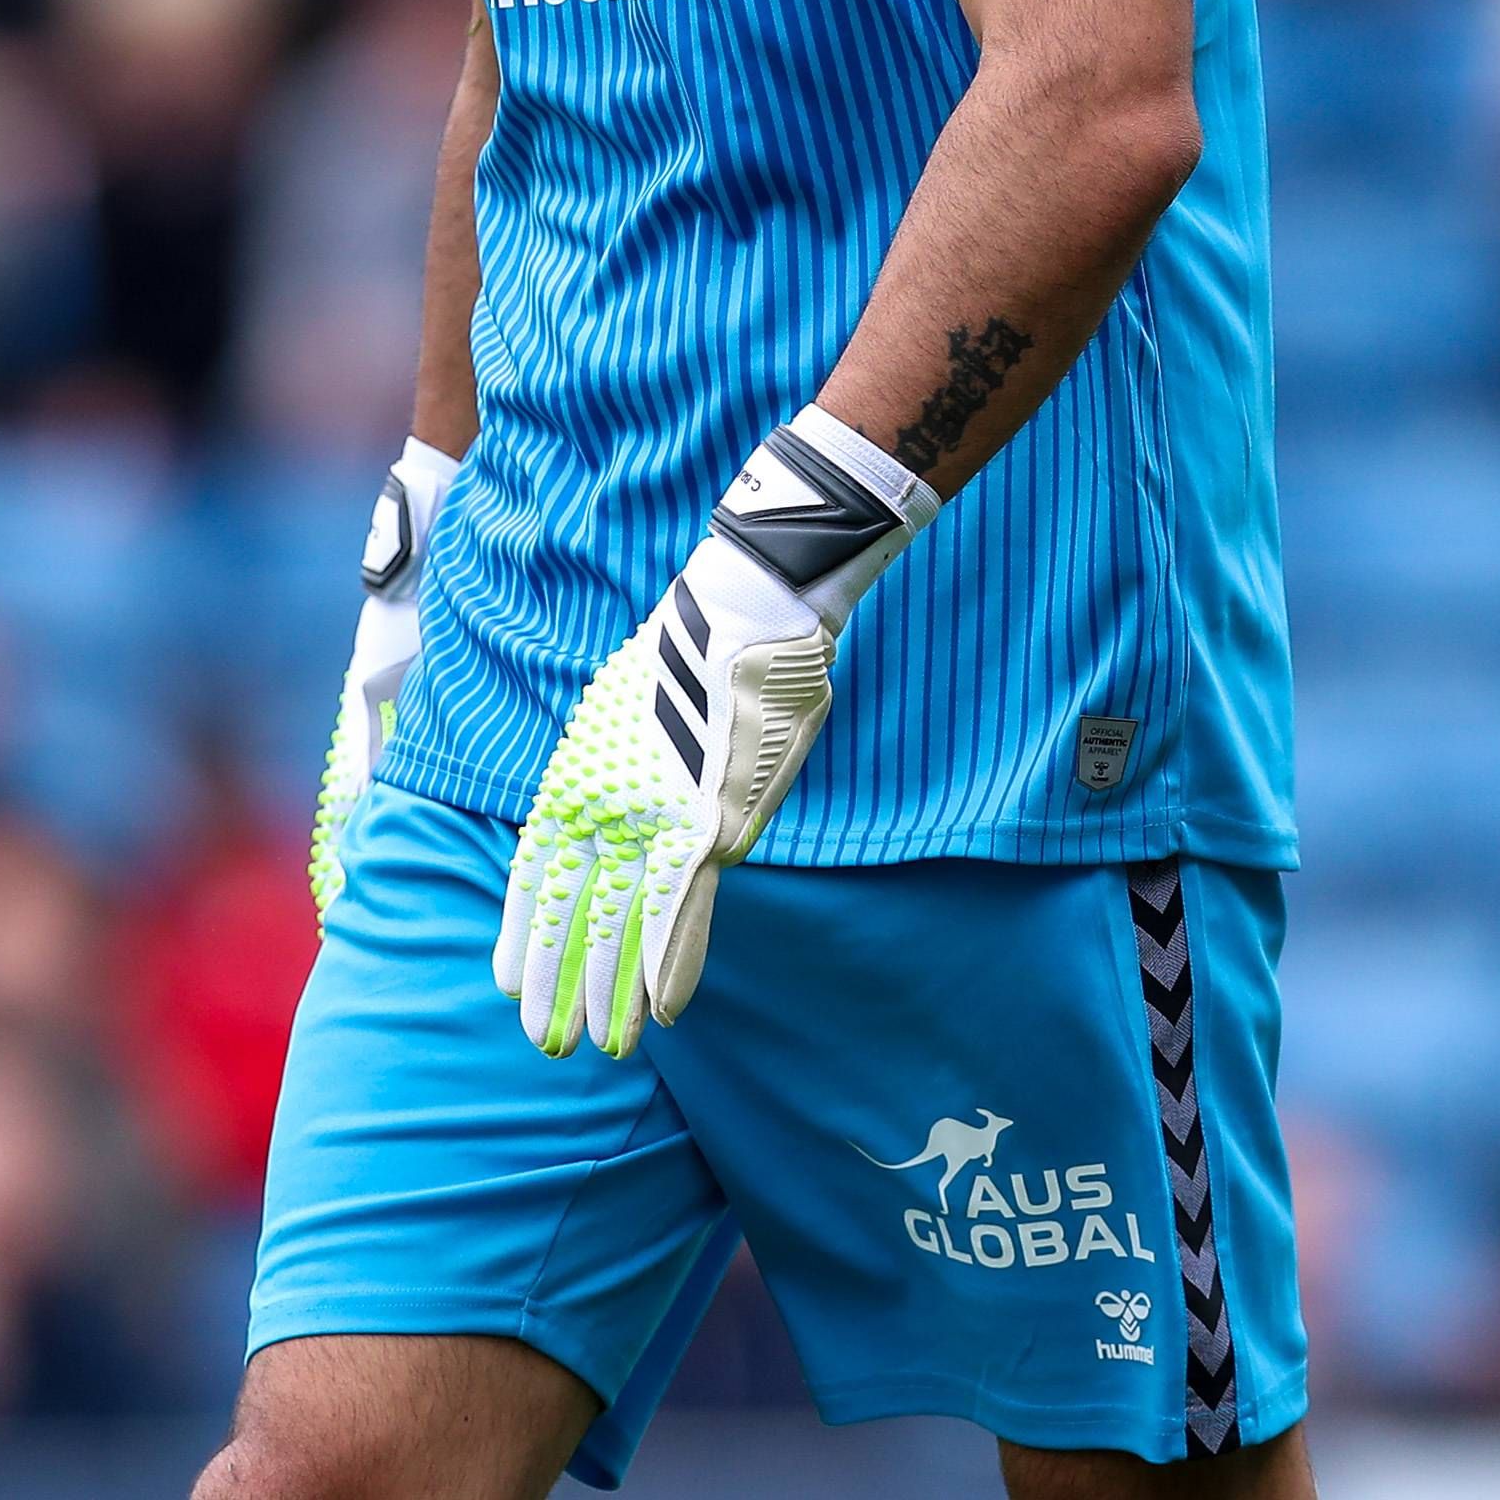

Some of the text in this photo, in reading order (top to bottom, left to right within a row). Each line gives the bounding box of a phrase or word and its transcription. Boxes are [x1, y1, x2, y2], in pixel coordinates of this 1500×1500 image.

[966, 1162, 1113, 1219] AUS
[903, 1207, 1156, 1269] GLOBAL
[1095, 1338, 1155, 1366] hummel
